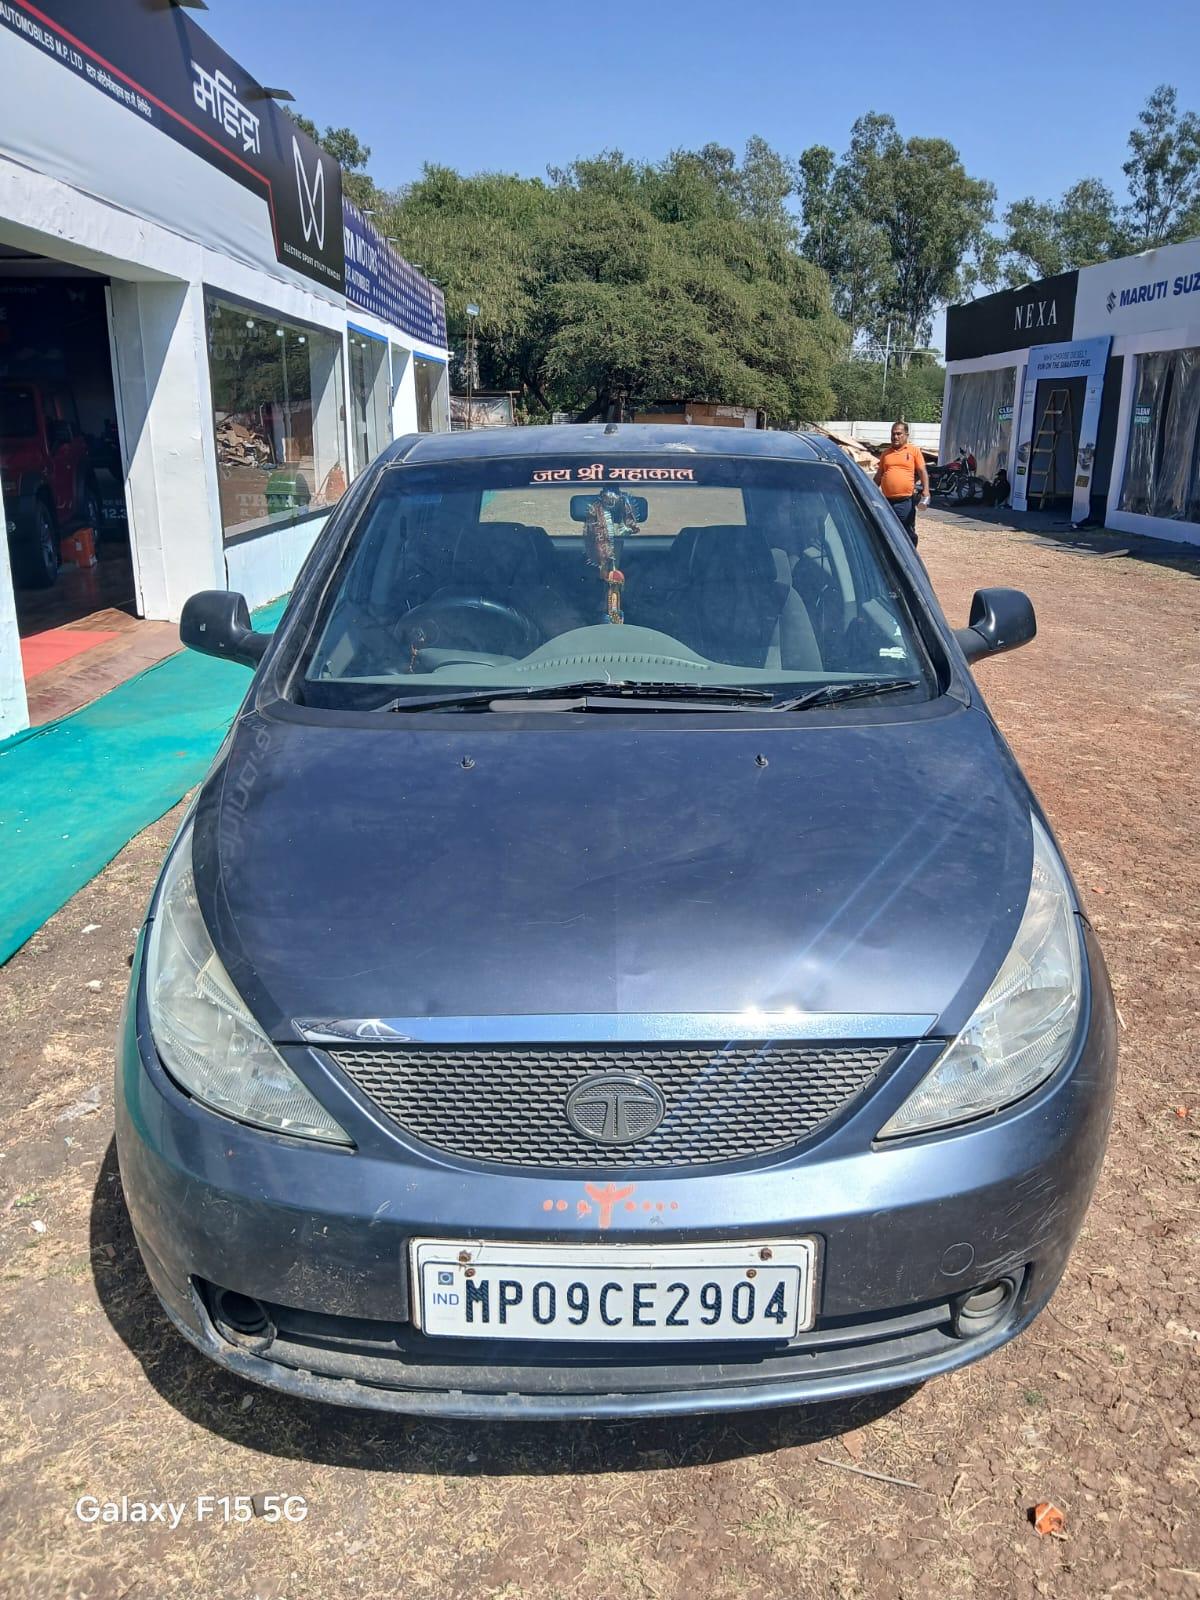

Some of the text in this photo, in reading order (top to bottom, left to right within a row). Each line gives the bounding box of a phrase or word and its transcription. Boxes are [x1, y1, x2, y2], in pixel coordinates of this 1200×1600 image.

[0, 2, 55, 51] AUTOMOBILES
[70, 49, 83, 70] LTD
[1119, 280, 1168, 307] MARUTI
[1014, 299, 1057, 330] NEXA
[533, 463, 694, 481] जय श्री महाकाल
[432, 1292, 460, 1306] IND
[465, 1279, 788, 1326] MP09CE2904
